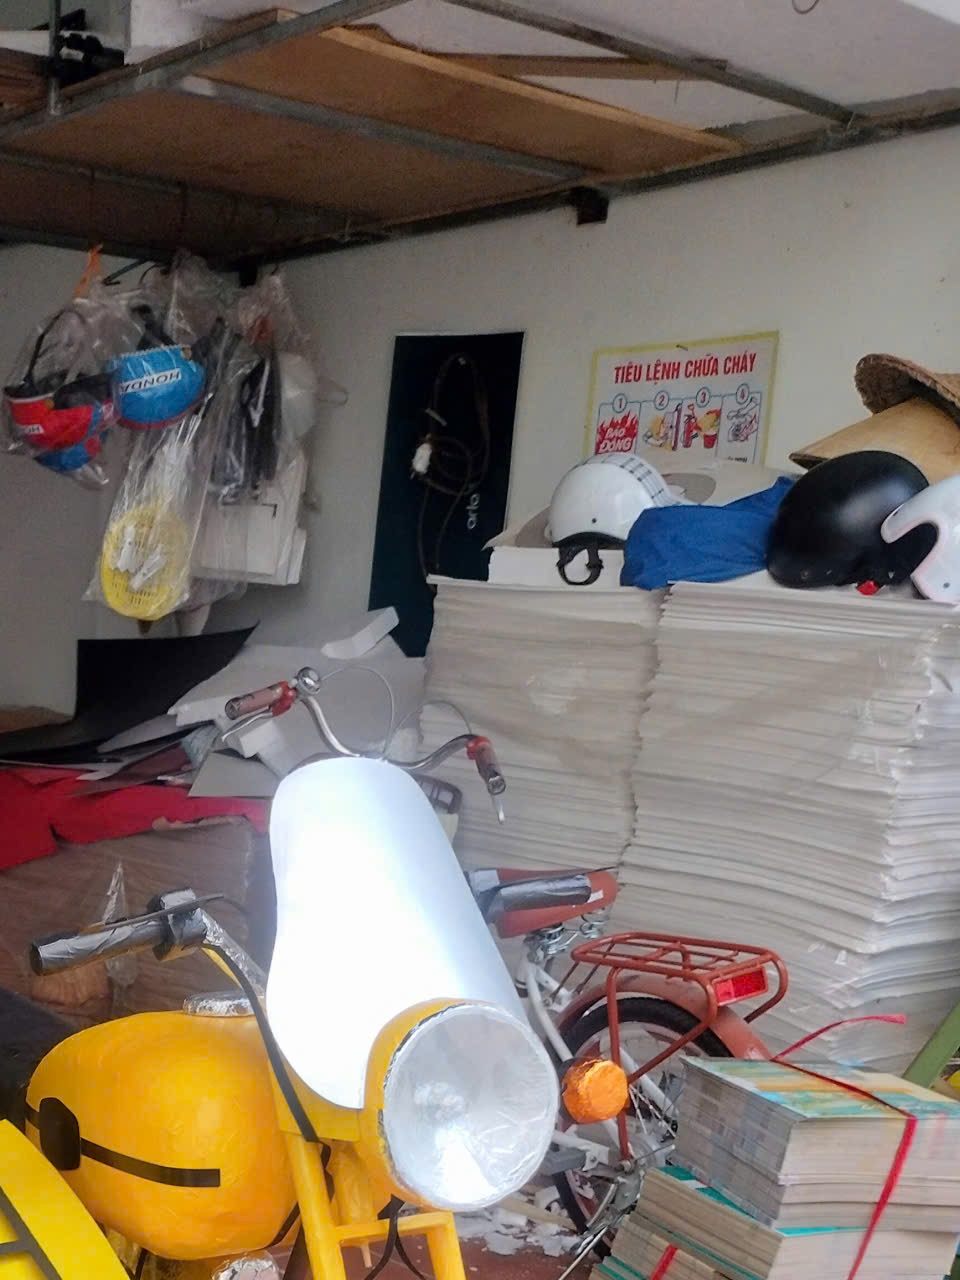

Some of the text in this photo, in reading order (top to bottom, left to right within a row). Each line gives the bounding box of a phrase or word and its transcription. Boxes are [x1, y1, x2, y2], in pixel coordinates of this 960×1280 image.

[120, 370, 181, 393] HONDA
[614, 350, 757, 386] TIÊU LỆNH CHỮA CHÁY
